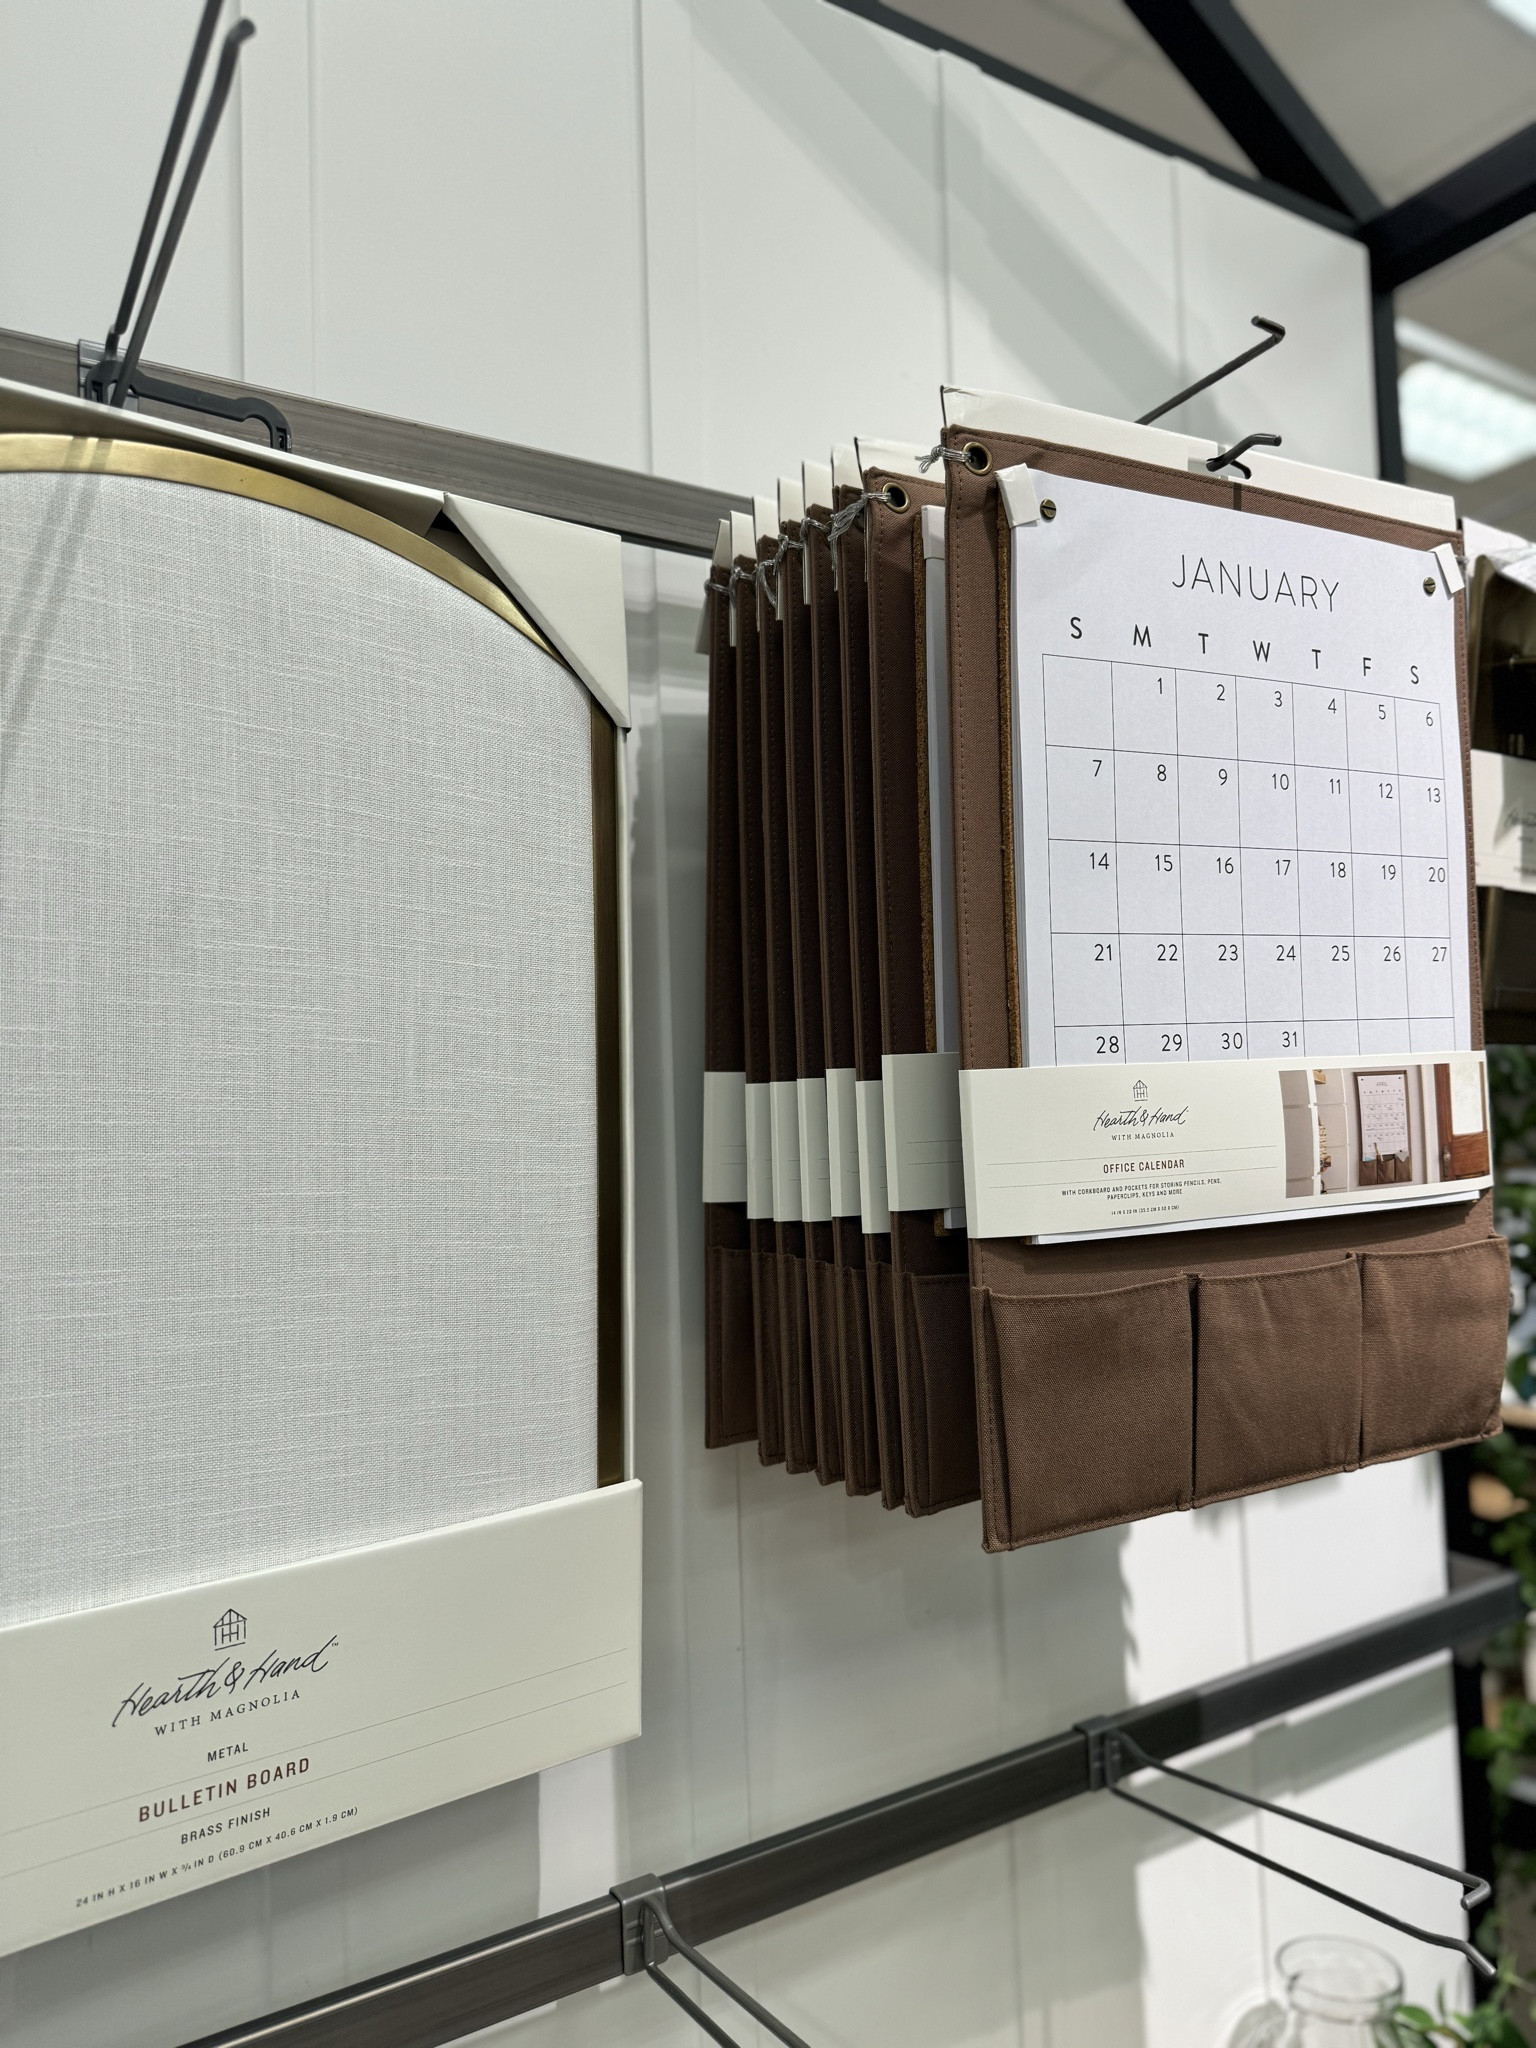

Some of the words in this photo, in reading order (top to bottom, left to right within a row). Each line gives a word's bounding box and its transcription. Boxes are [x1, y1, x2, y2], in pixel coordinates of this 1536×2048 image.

[1171, 554, 1339, 612] JANUARY
[1069, 616, 1083, 639] S
[1133, 624, 1152, 648] M
[1198, 633, 1209, 654] T
[1253, 640, 1271, 662] W
[1311, 649, 1321, 669] T
[1363, 657, 1372, 676] F
[1410, 665, 1420, 685] S
[1157, 678, 1163, 695] 1
[1216, 684, 1225, 701] 2
[1274, 691, 1282, 707] 3
[1327, 698, 1337, 714] 4
[1378, 704, 1386, 720] 5
[1425, 711, 1433, 727] 6
[1092, 760, 1102, 777] 7
[1157, 764, 1167, 782] 8
[1218, 768, 1228, 785] 9
[1271, 773, 1289, 791] 10
[1329, 778, 1342, 795] 11
[1378, 783, 1393, 799] 12
[1427, 787, 1441, 803] 13
[1089, 852, 1110, 871] 14
[1155, 854, 1173, 872] 15
[1216, 857, 1234, 875] 16
[1275, 859, 1292, 876] 17
[1330, 862, 1346, 879] 18
[1381, 864, 1396, 880] 19
[1428, 867, 1446, 883] 20
[1094, 943, 1113, 962] 21
[1157, 943, 1178, 962] 22
[1218, 943, 1239, 962] 23
[1276, 944, 1296, 962] 24
[1331, 945, 1350, 962] 25
[1383, 946, 1401, 962] 26
[1432, 946, 1447, 962] 27
[1096, 1035, 1120, 1054] 28
[1161, 1034, 1183, 1052] 29
[1221, 1032, 1243, 1050] 30
[1281, 1031, 1298, 1049] 31
[1093, 1106, 1142, 1131] Hearth
[1139, 1109, 1149, 1126] &
[1134, 1132, 1175, 1140] MAGNOLIA
[1103, 1162, 1135, 1174] OFFICE
[1138, 1159, 1185, 1171] CALENDAR
[1078, 1187, 1110, 1195] CORKBOARD
[1161, 1181, 1182, 1189] STORING
[111, 1657, 230, 1727] Hearth
[224, 1661, 245, 1694] &
[154, 1715, 201, 1736] WITH
[210, 1689, 301, 1721] MAGNOLIA
[207, 1742, 248, 1762] METAL
[138, 1779, 238, 1822] BULLETIN
[247, 1757, 310, 1790] BOARD
[181, 1823, 223, 1844] BRASS
[228, 1807, 271, 1829] FINISH
[76, 1896, 88, 1907] 24
[93, 1891, 104, 1901] IN
[108, 1888, 115, 1896] H
[130, 1879, 141, 1889] 16
[145, 1874, 155, 1885] IN
[159, 1870, 168, 1879] W
[171, 1867, 178, 1876] X
[194, 1858, 204, 1868] IN
[208, 1855, 214, 1863] D
[219, 1844, 245, 1861] (60.9
[248, 1839, 262, 1850] CM
[266, 1836, 272, 1844] X
[275, 1827, 296, 1841] 40.6
[299, 1822, 313, 1833] CM
[316, 1819, 322, 1827] X
[325, 1814, 338, 1825] 1.9
[341, 1806, 358, 1819] CM)
